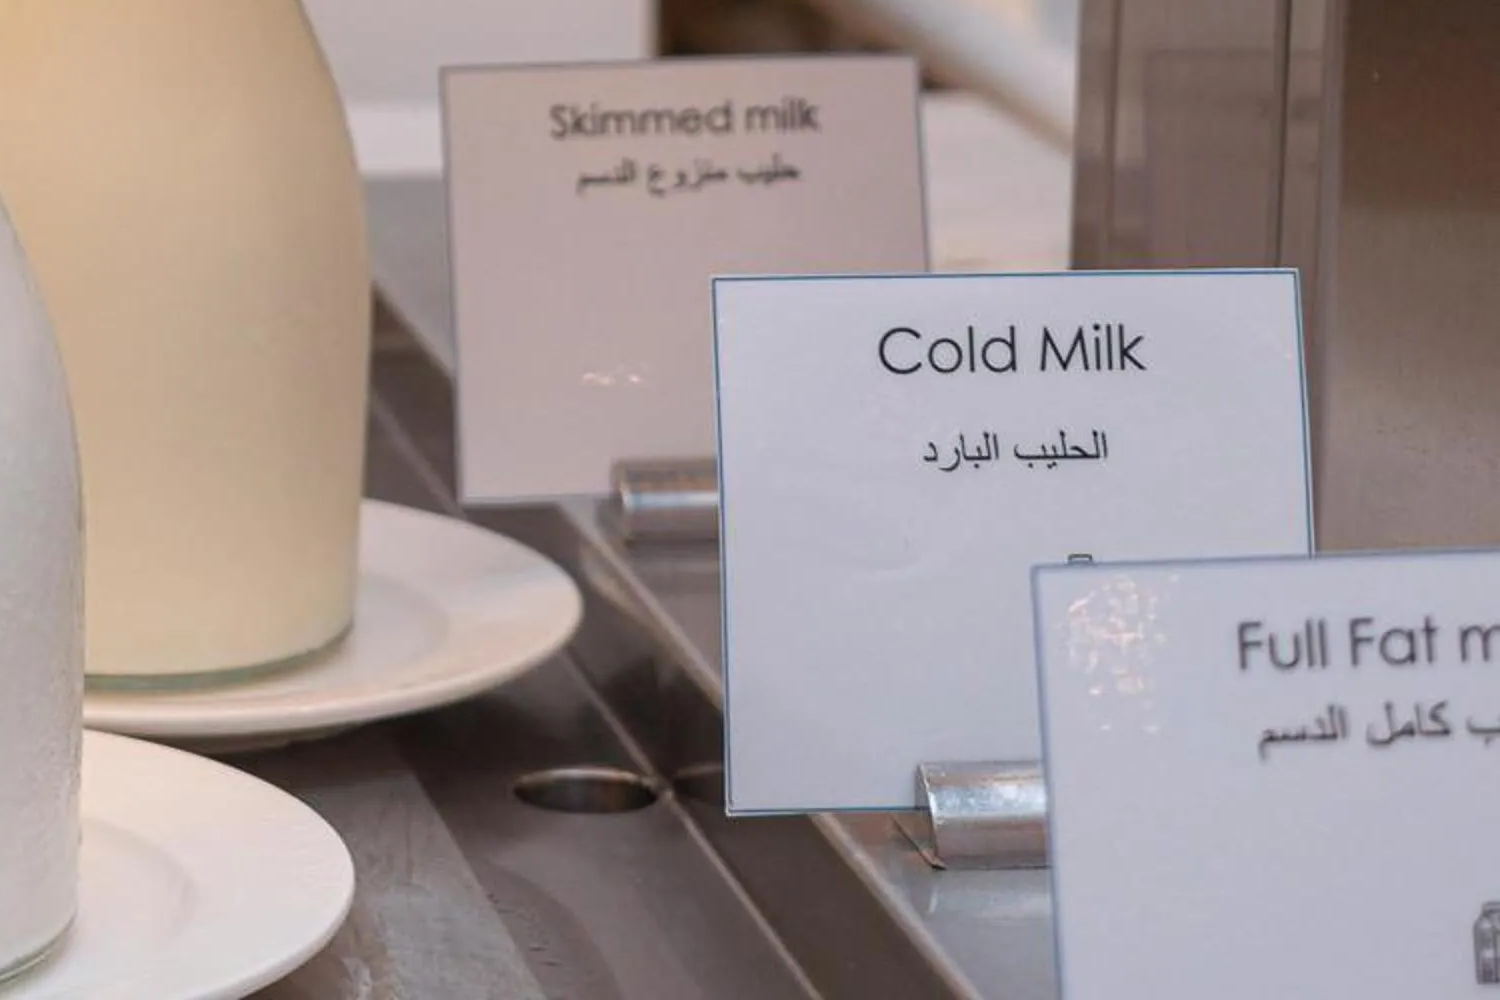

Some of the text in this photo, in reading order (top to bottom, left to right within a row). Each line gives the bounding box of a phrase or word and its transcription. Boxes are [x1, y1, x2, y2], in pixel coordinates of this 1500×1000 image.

[549, 96, 819, 140] Skimmed milk
[877, 321, 1148, 377] Cold Milk
[922, 428, 1109, 474] الحليب البارد
[1236, 617, 1330, 672] Full
[1348, 614, 1440, 668] Fat
[1257, 703, 1350, 762] الدسم
[1365, 699, 1454, 749] كامل
